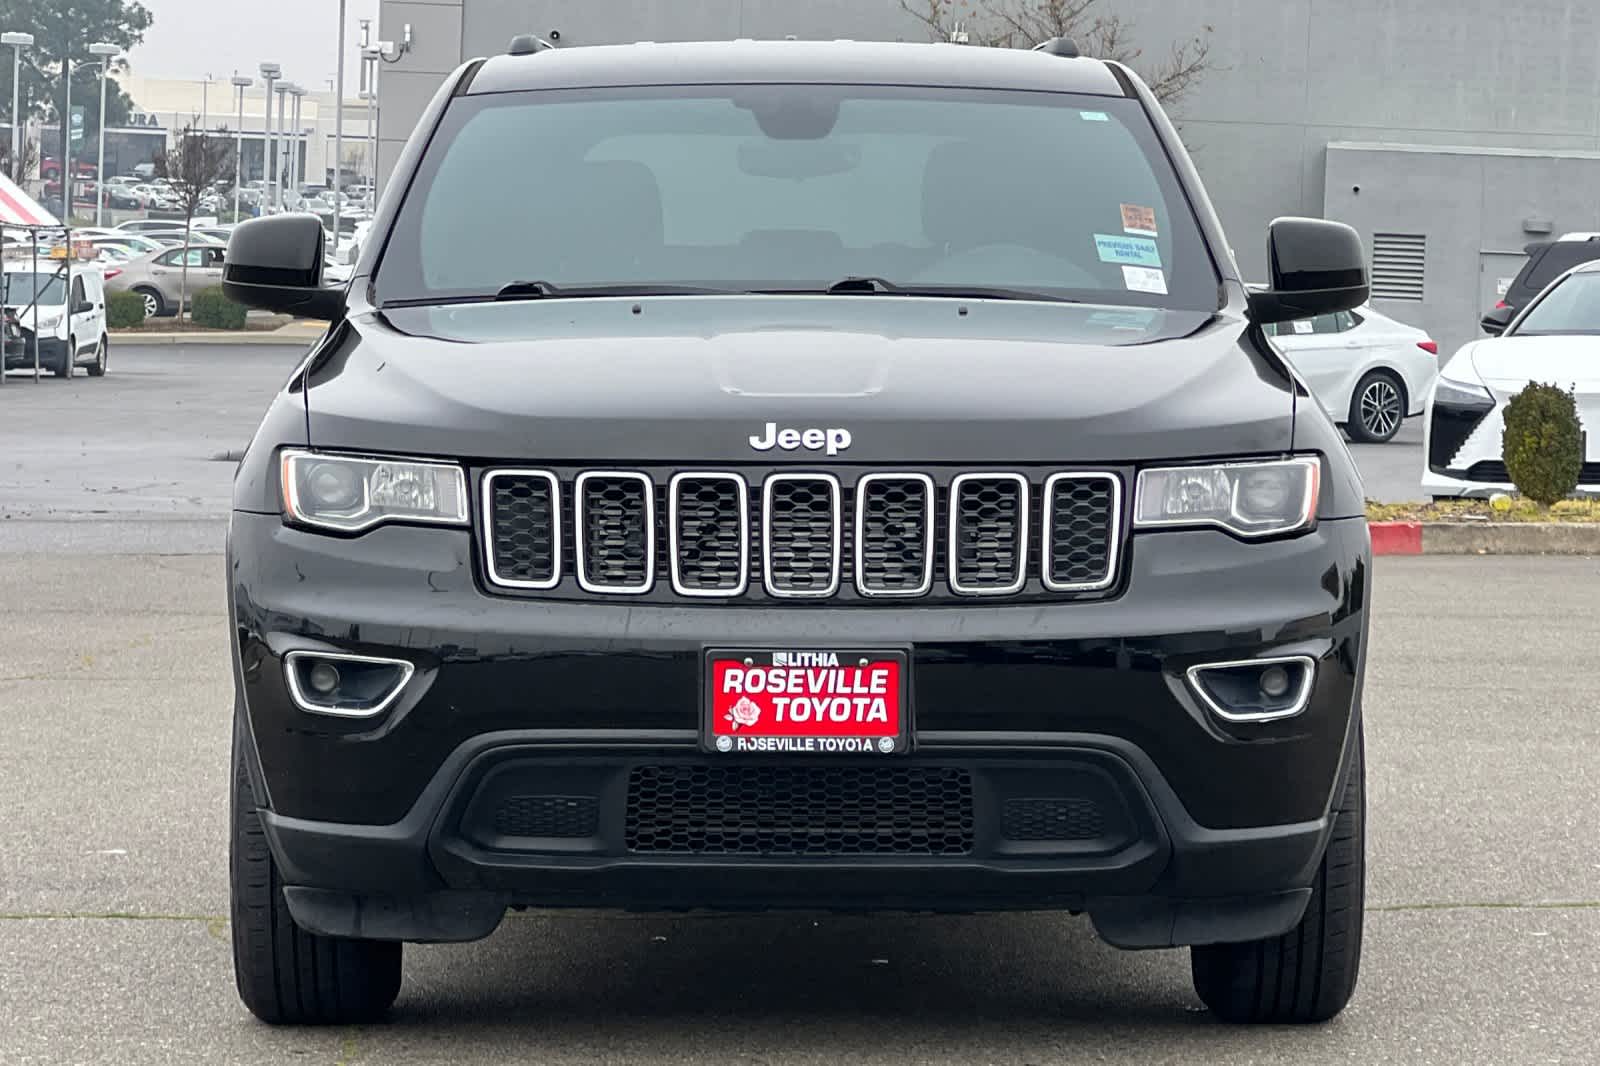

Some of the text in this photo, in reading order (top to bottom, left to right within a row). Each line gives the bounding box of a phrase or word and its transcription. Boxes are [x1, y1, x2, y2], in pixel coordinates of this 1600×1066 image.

[128, 113, 159, 126] URA
[749, 422, 851, 456] Jeep
[788, 652, 839, 667] LITHIA
[723, 669, 888, 694] ROSEVILLE
[772, 697, 888, 722] TOYOTA
[737, 737, 873, 752] ROSEVILLE TOYOTA
